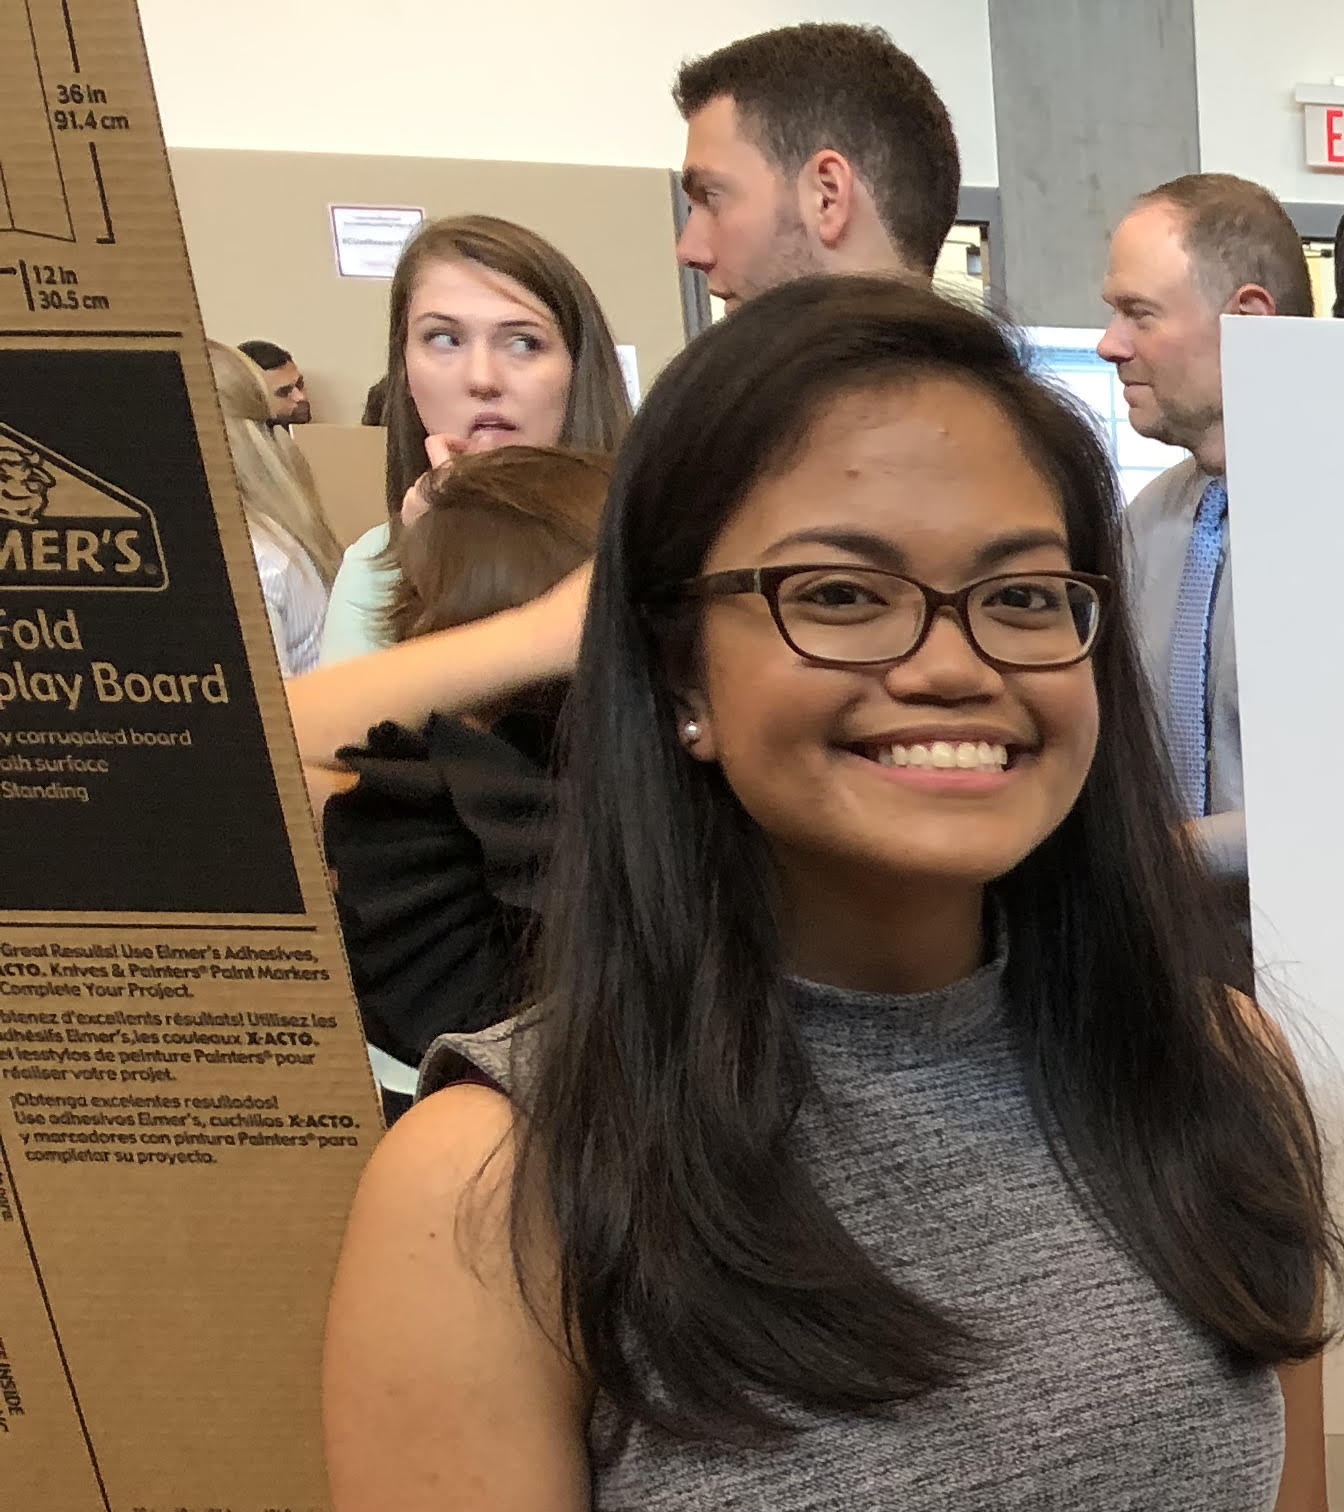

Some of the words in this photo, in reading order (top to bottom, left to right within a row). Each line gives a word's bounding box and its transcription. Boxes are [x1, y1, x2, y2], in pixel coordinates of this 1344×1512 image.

[56, 84, 84, 104] 36
[54, 110, 98, 130] 91.4
[101, 114, 130, 130] cm
[33, 265, 57, 284] 12
[38, 290, 80, 309] 30.5
[82, 294, 110, 309] cm
[91, 662, 229, 703] Board
[16, 730, 127, 747] corrugated
[131, 729, 192, 746] board
[36, 755, 109, 773] surface
[2, 782, 89, 801] Standing
[121, 944, 153, 959] Use
[50, 963, 108, 978] Knives
[112, 963, 124, 977] &
[211, 965, 254, 979] Paint
[258, 965, 330, 980] Markers
[83, 982, 125, 997] Your
[128, 983, 195, 1000] Project.
[91, 1095, 181, 1108] excelentes
[15, 1111, 46, 1125] Use
[19, 1132, 30, 1145] y
[34, 1130, 137, 1143] marcadores
[141, 1132, 171, 1144] con
[318, 1135, 358, 1148] para
[25, 1149, 110, 1164] completar
[115, 1151, 133, 1163] su
